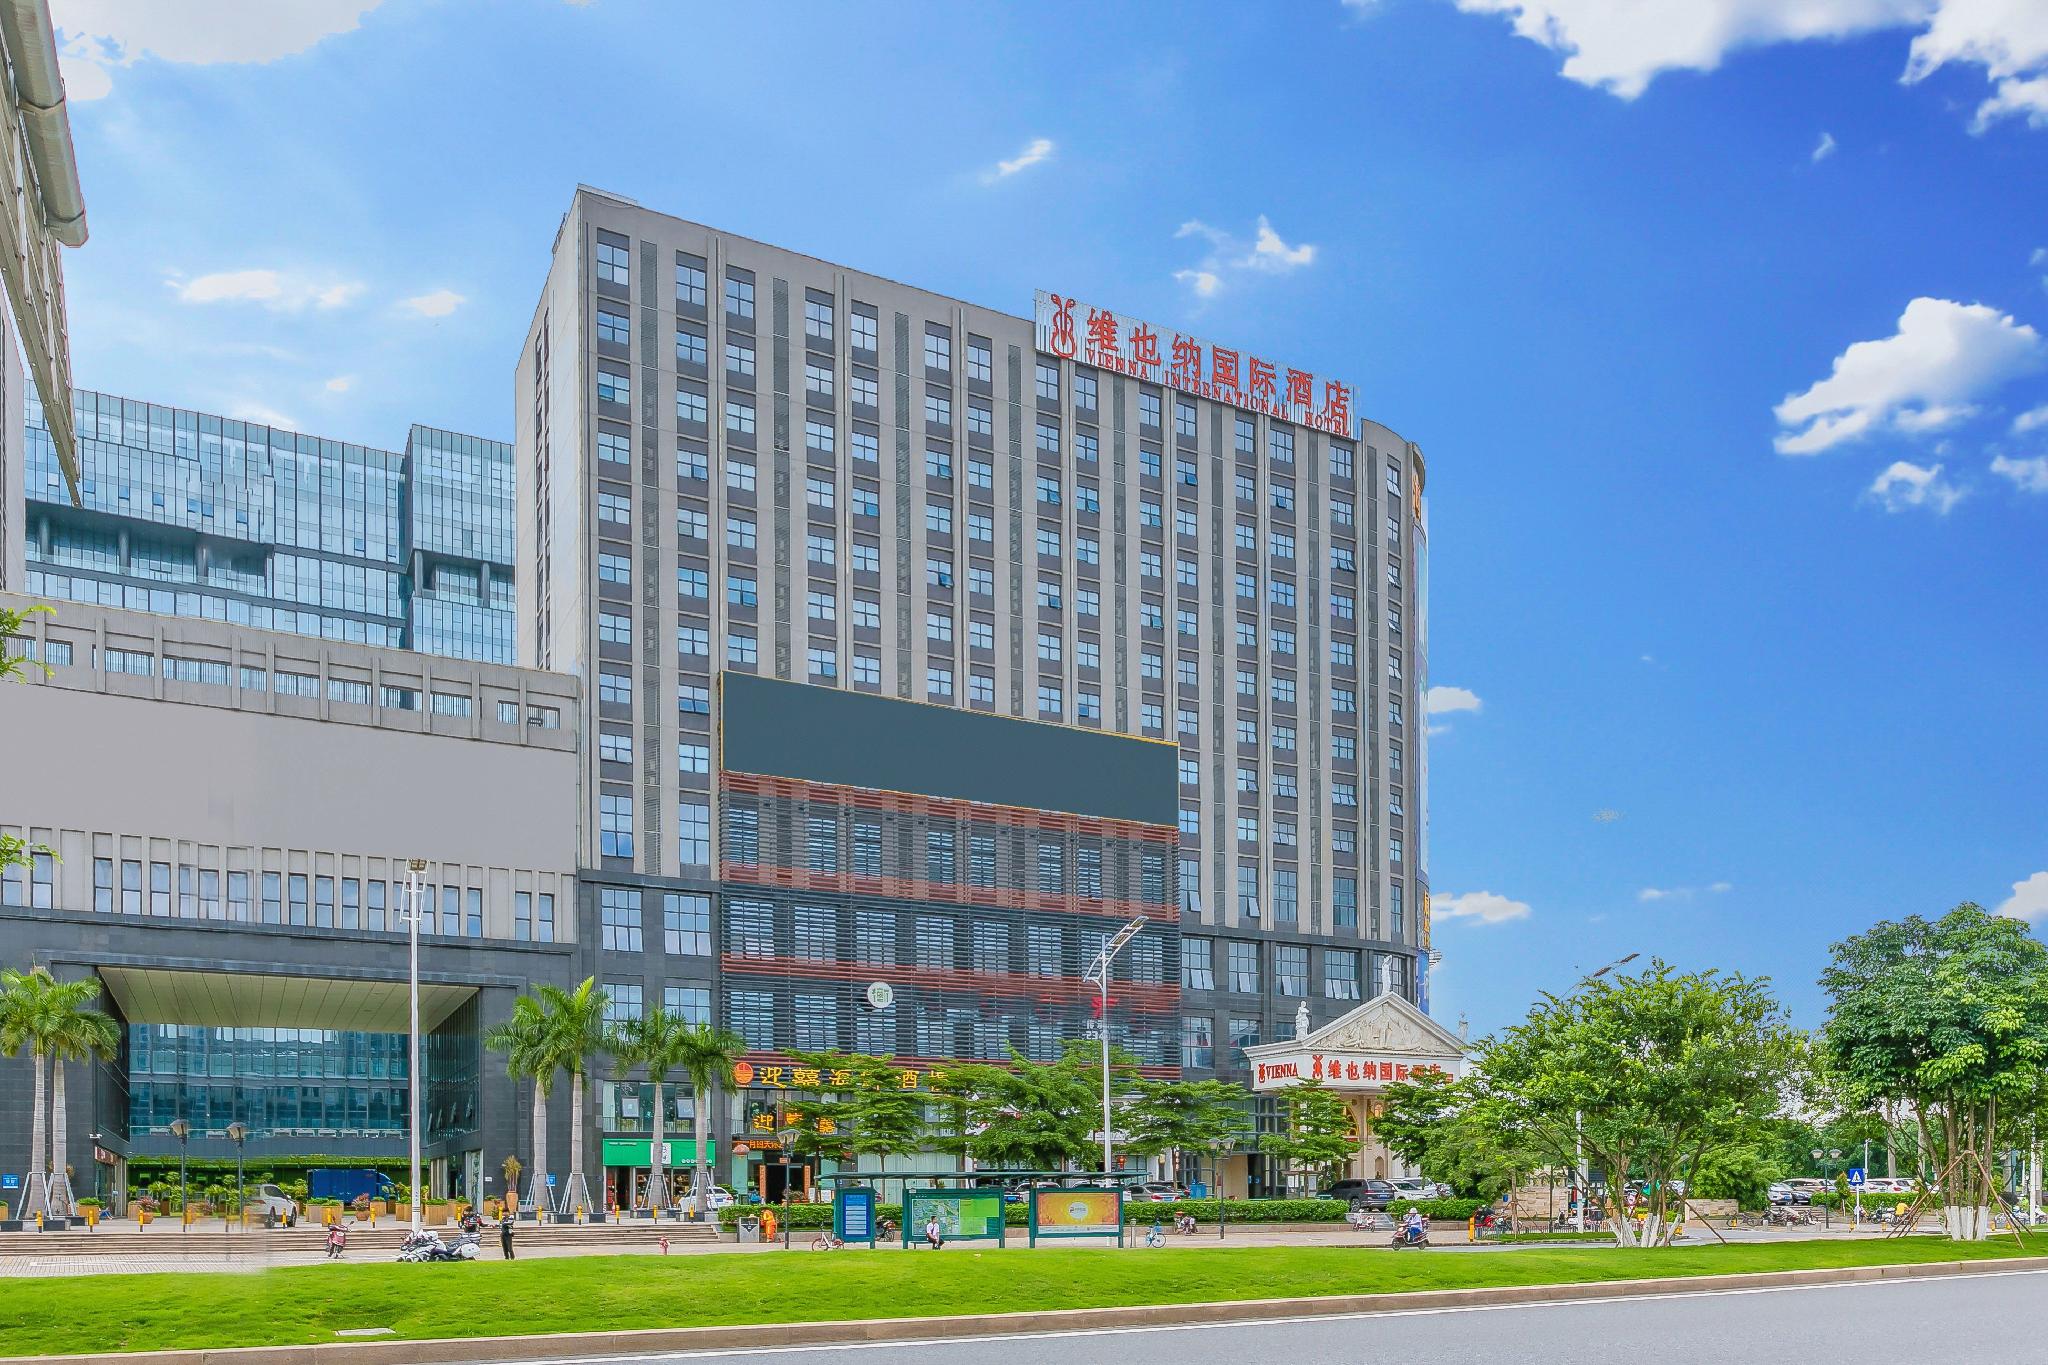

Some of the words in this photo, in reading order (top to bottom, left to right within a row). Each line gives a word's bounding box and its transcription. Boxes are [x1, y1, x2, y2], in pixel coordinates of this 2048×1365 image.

[1086, 348, 1149, 380] VIENNA
[1163, 370, 1288, 420] INTERNATIONAL
[1305, 411, 1349, 437] HOTEL
[1087, 308, 1349, 419] 维也纳国际酒店
[1266, 1062, 1298, 1079] VIENNA
